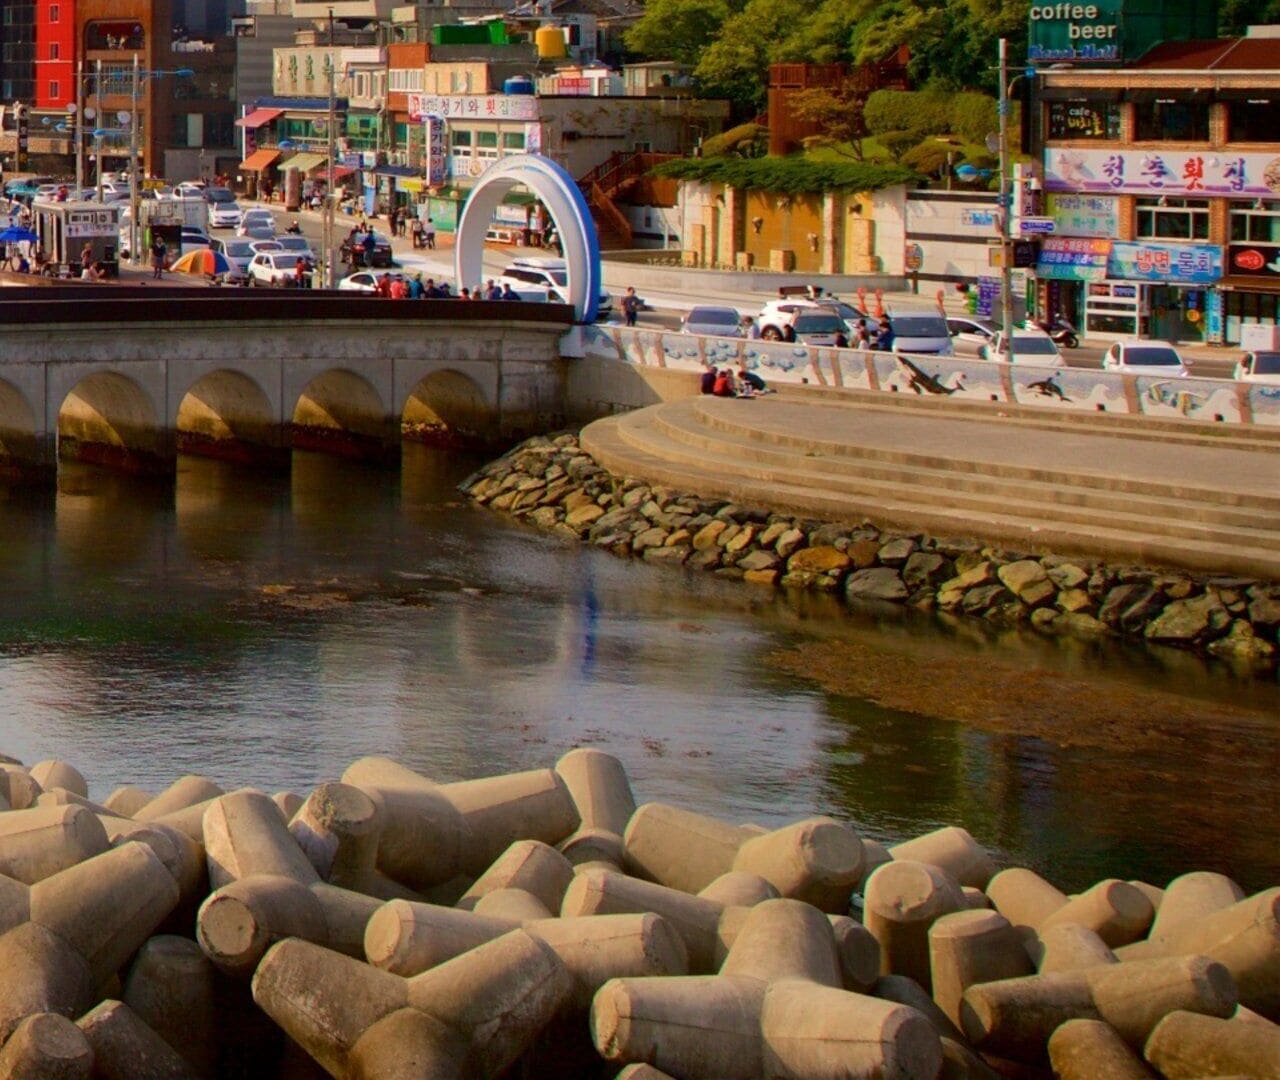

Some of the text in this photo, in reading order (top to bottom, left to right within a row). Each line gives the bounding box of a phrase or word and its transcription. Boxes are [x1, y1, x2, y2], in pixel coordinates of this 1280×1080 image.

[1030, 3, 1098, 20] coffee
[1068, 22, 1117, 39] beer
[1136, 250, 1170, 273] 냉면
